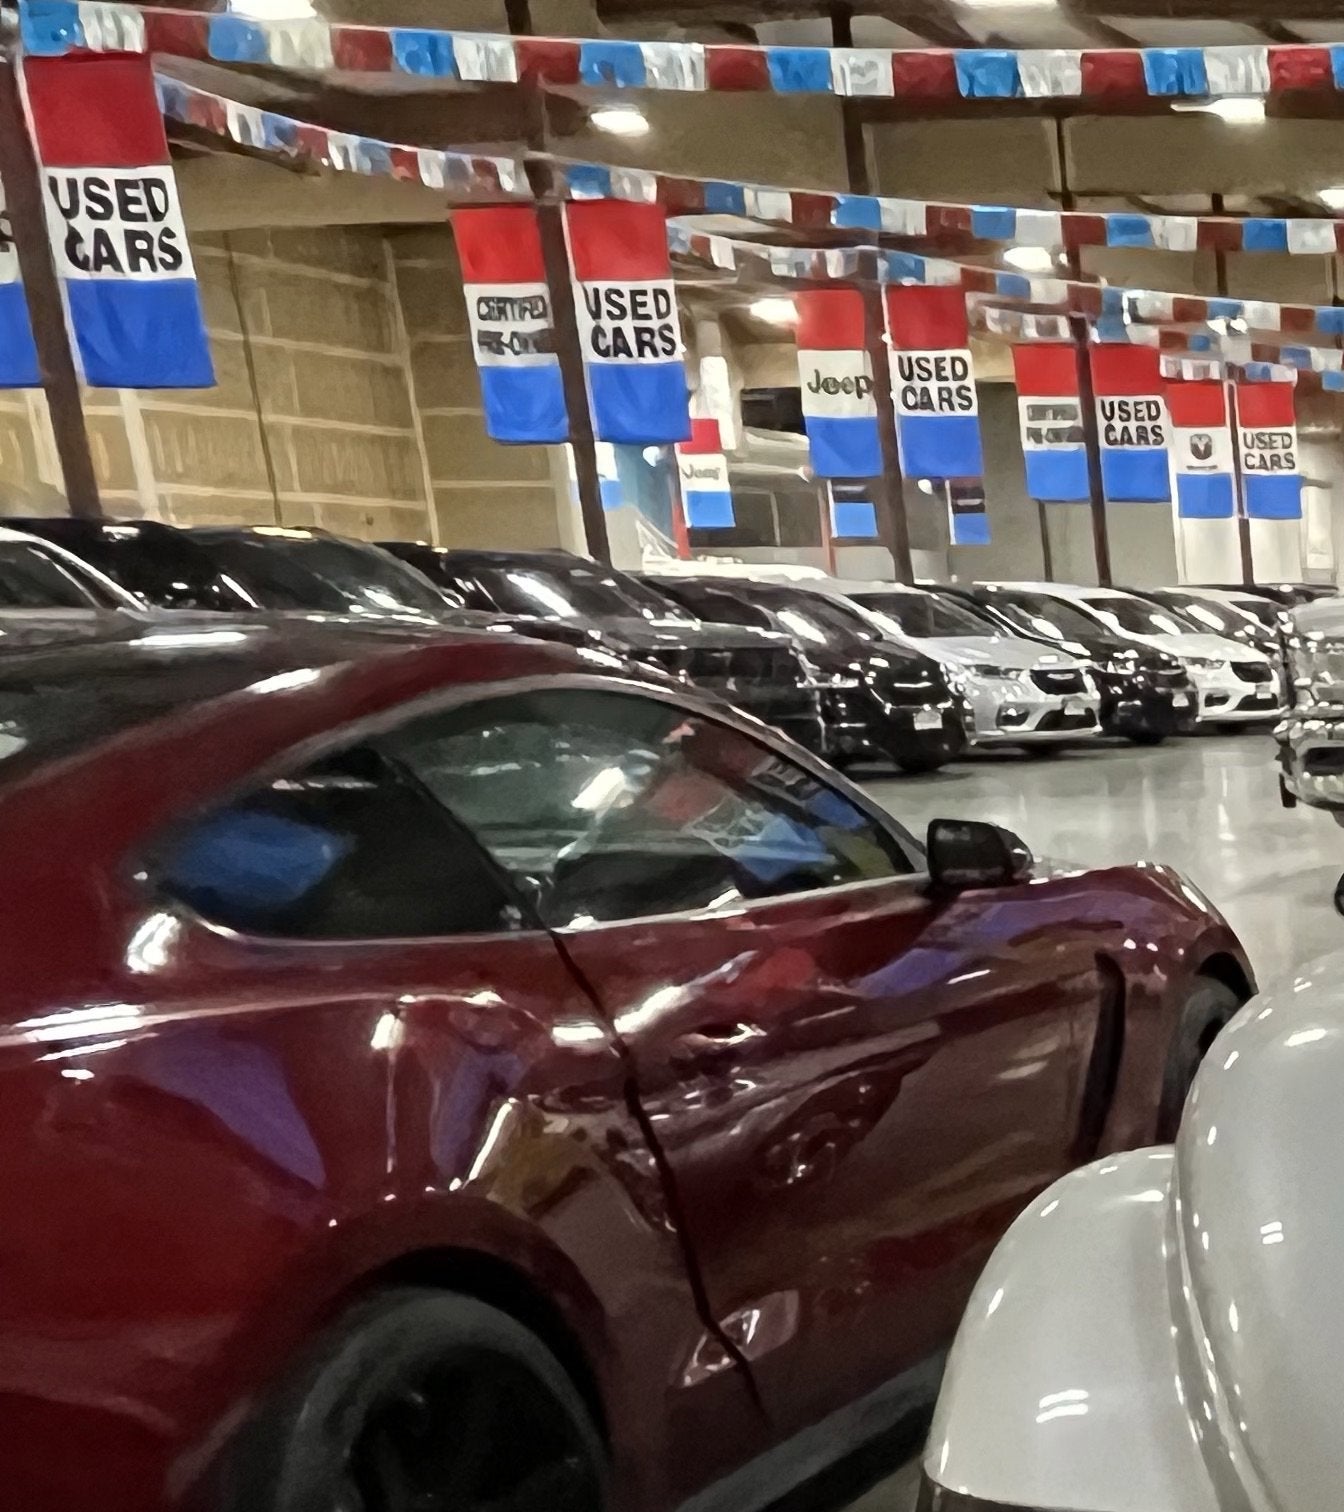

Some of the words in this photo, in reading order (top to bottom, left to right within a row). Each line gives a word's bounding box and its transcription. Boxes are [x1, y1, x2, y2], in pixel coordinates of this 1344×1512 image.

[48, 175, 169, 222] USED
[65, 221, 182, 274] CARS
[582, 286, 671, 321] USED
[591, 323, 677, 358] CARS
[898, 355, 968, 381] USED
[807, 369, 875, 399] Jeep
[901, 385, 973, 412] CARS
[1100, 399, 1161, 422] USED
[1104, 424, 1164, 447] CARS
[1243, 431, 1292, 450] USED
[1244, 453, 1295, 471] CARS
